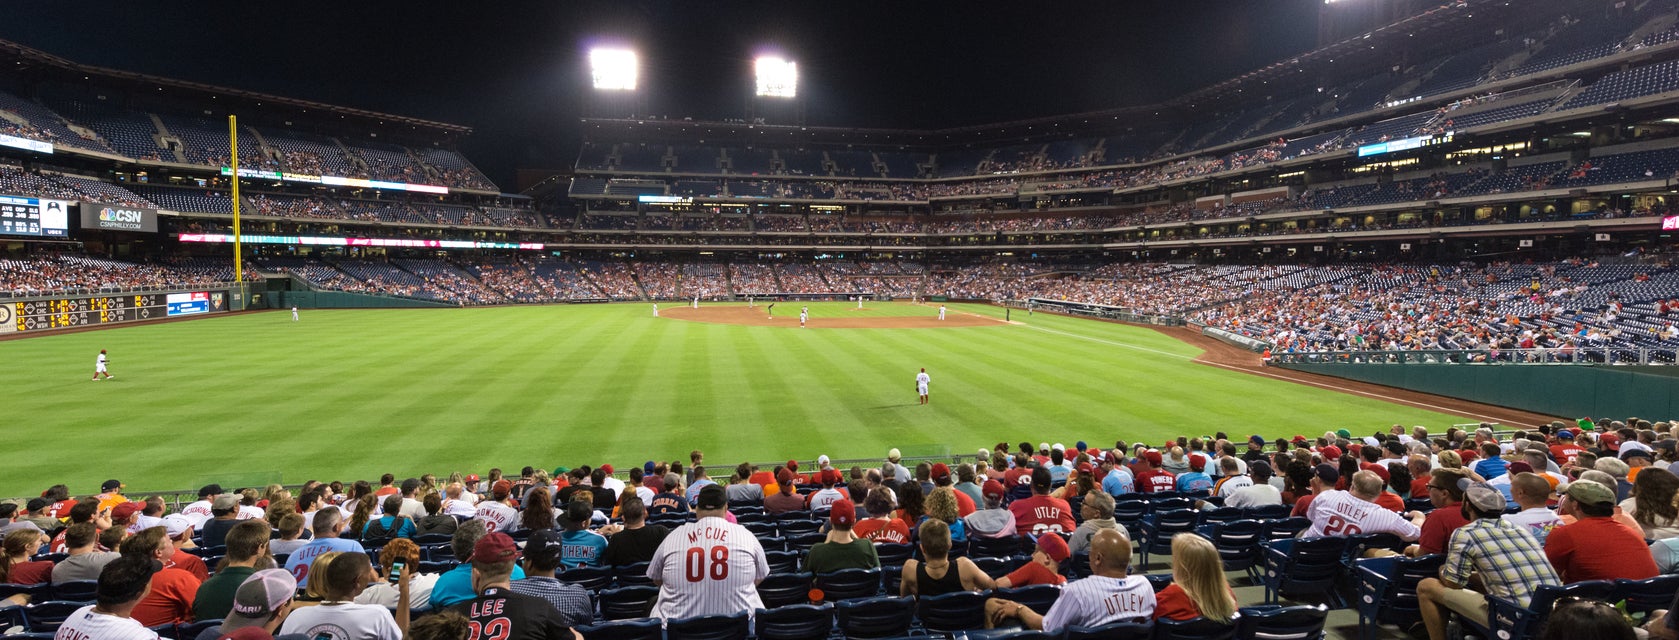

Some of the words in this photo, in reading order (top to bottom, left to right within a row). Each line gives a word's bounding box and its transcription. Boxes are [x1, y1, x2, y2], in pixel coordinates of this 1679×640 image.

[116, 210, 141, 222] CSN
[1034, 506, 1060, 519] UTLEY
[1337, 502, 1368, 521] UTLEY
[686, 545, 729, 583] 08
[471, 598, 506, 618] LEE
[1104, 593, 1144, 615] UTLEY
